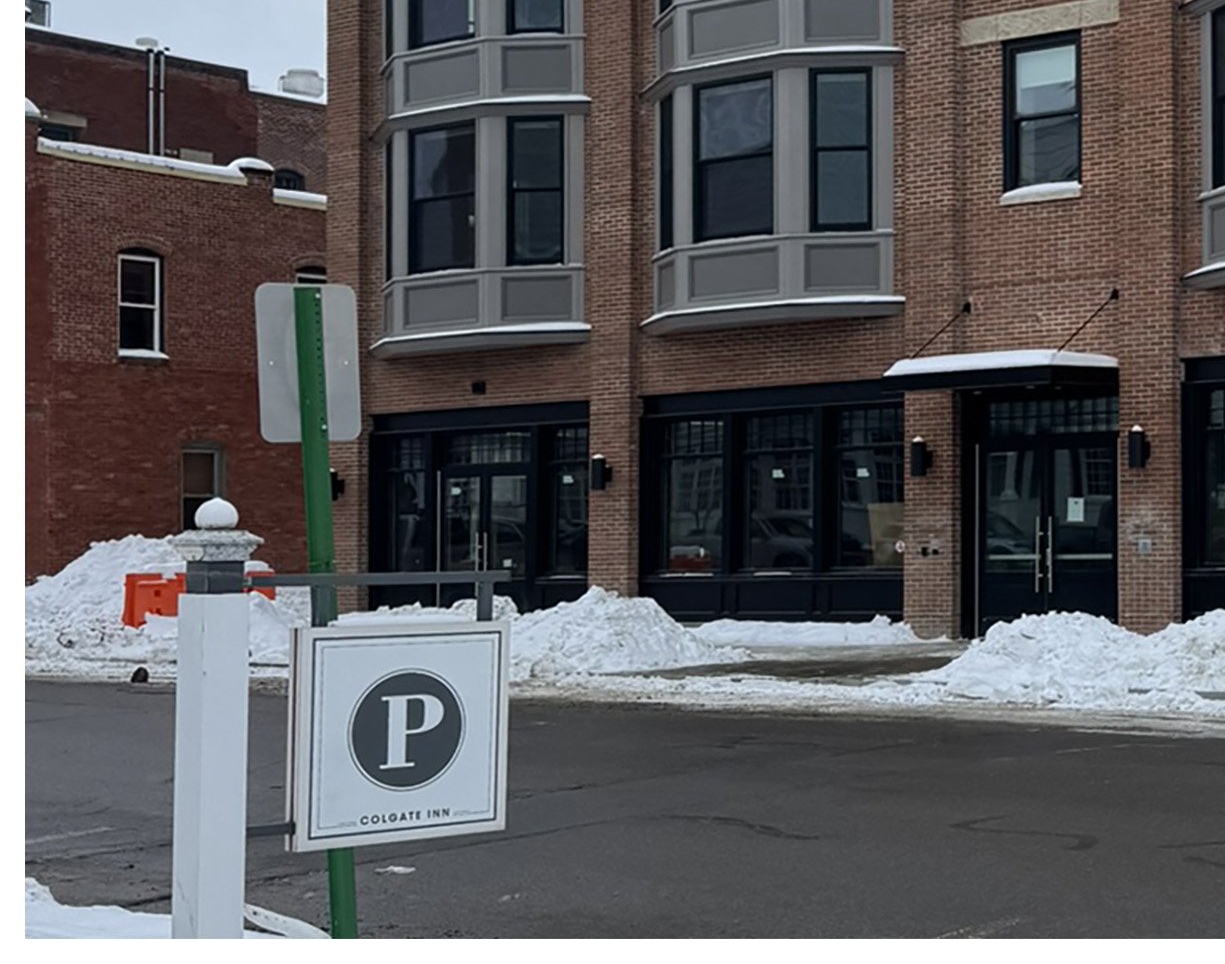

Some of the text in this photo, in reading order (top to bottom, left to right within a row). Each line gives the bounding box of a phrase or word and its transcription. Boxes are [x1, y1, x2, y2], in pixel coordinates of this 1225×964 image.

[379, 694, 445, 770] P
[359, 807, 451, 826] COLGATE INN
